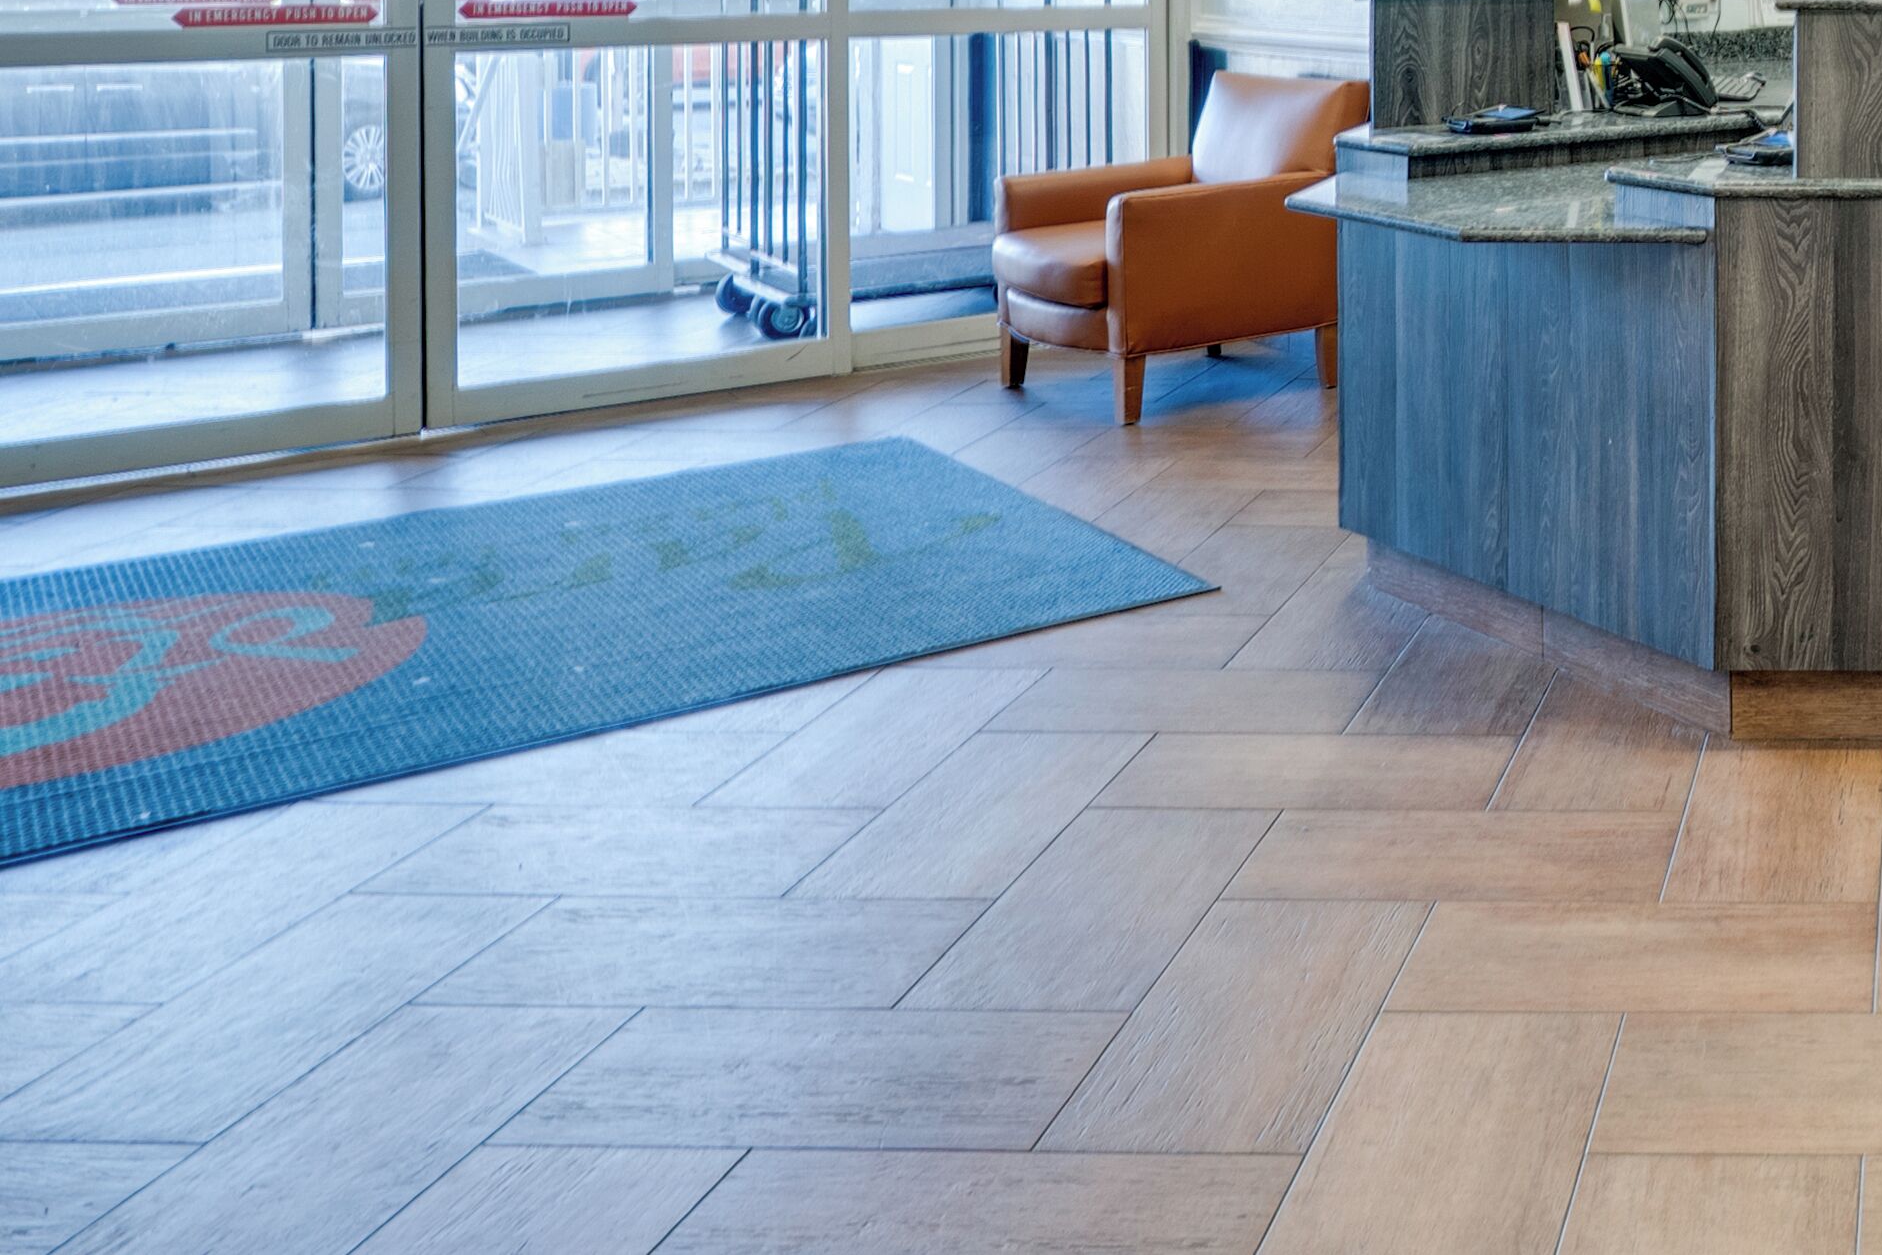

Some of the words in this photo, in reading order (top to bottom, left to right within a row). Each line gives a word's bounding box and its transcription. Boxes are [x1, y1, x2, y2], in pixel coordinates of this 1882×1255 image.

[188, 9, 200, 22] IN
[206, 8, 277, 22] EMERGENCY
[285, 7, 316, 20] PUSH
[321, 6, 333, 19] TO
[338, 6, 368, 19] OPEN
[472, 3, 483, 16] IN
[487, 2, 550, 15] EMERGENCY
[557, 1, 584, 14] PUSH
[587, 1, 598, 13] TO
[602, 1, 627, 13] OPEN
[273, 34, 300, 48] DOOR
[305, 34, 317, 47] TO
[322, 33, 361, 46] REMAIN
[365, 31, 416, 45] UNLOCKED
[427, 30, 456, 43] WHEN
[459, 28, 502, 42] BUILDING
[506, 28, 516, 41] IS
[520, 27, 564, 41] OCCUPIED
